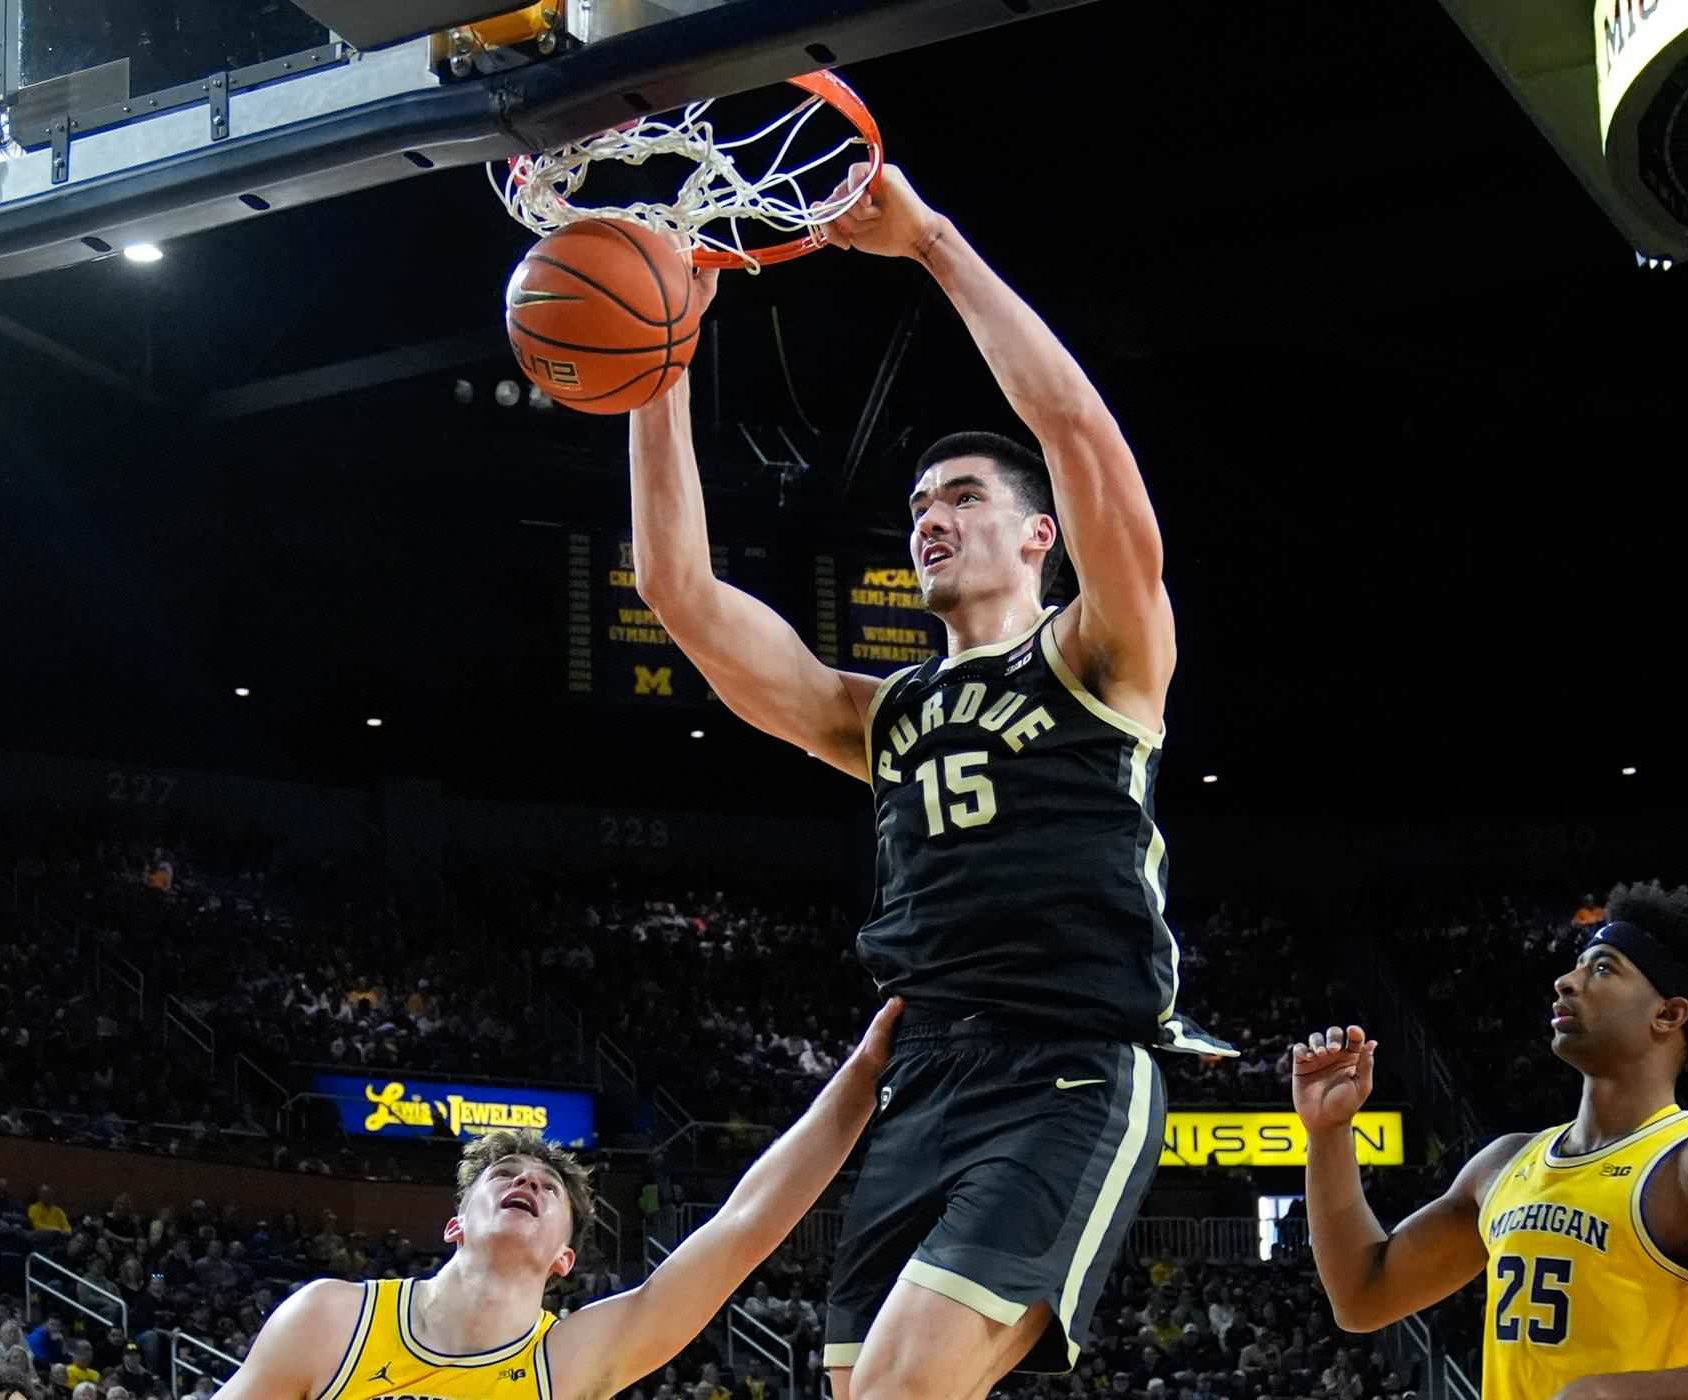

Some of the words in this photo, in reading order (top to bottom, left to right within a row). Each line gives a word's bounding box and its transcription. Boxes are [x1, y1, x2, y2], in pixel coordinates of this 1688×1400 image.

[632, 663, 674, 697] M
[877, 682, 1056, 784] PURDUE
[914, 750, 997, 839] 15
[446, 1094, 548, 1137] JEWELERS
[1488, 1203, 1610, 1254] MICHIGAN
[1495, 1254, 1574, 1346] 25
